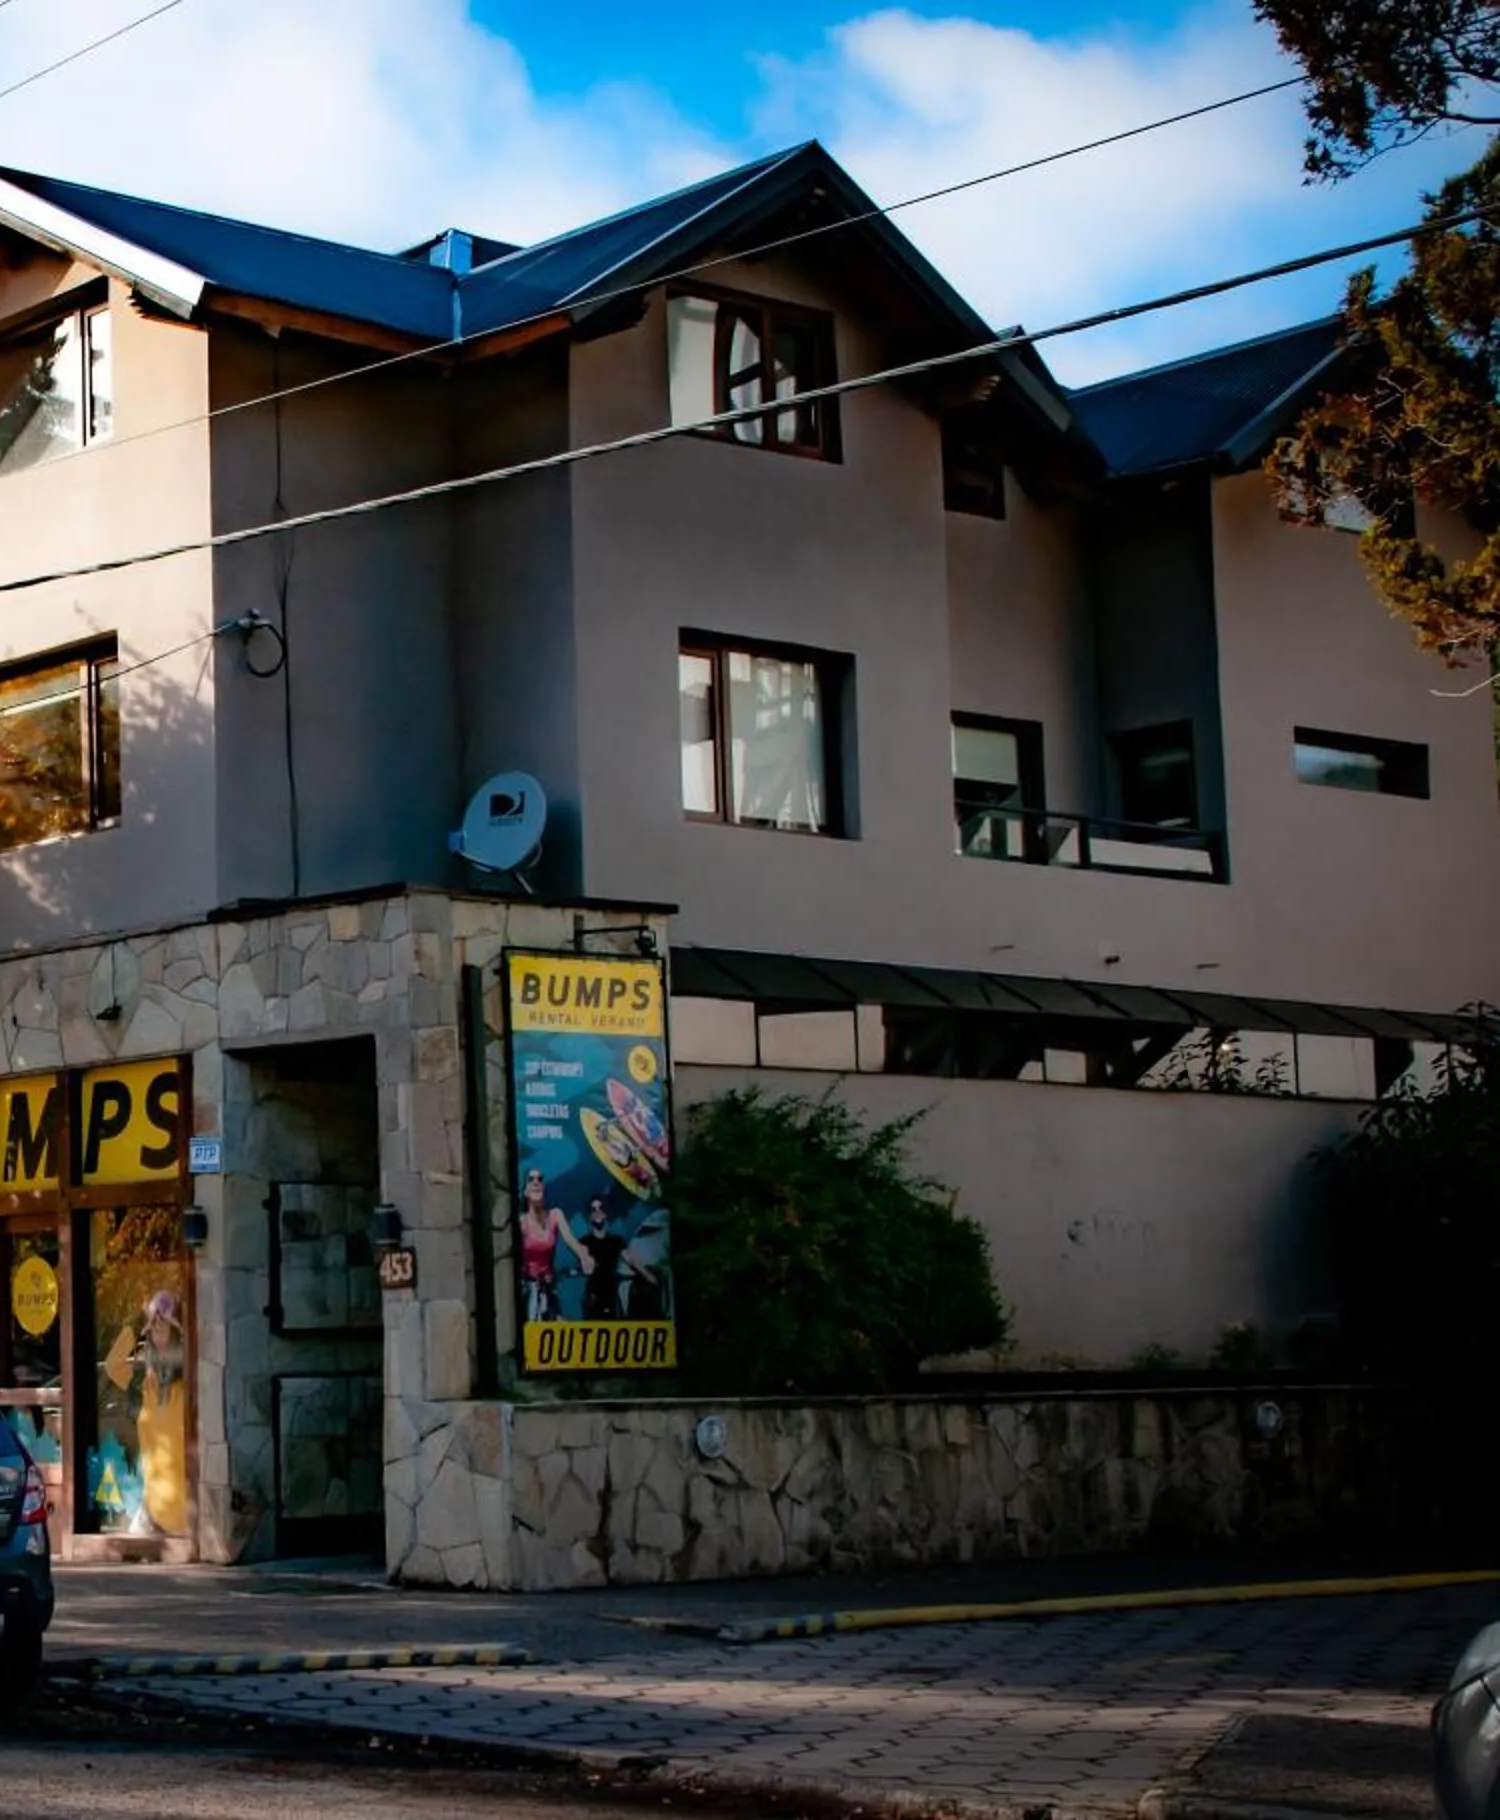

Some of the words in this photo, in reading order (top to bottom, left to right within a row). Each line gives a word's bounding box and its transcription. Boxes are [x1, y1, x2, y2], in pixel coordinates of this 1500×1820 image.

[520, 973, 651, 1011] BUMPS
[528, 1011, 581, 1026] RENTAL
[379, 1252, 413, 1283] 453
[17, 1292, 57, 1308] BUMPS
[538, 1328, 669, 1364] OUTDOOR
